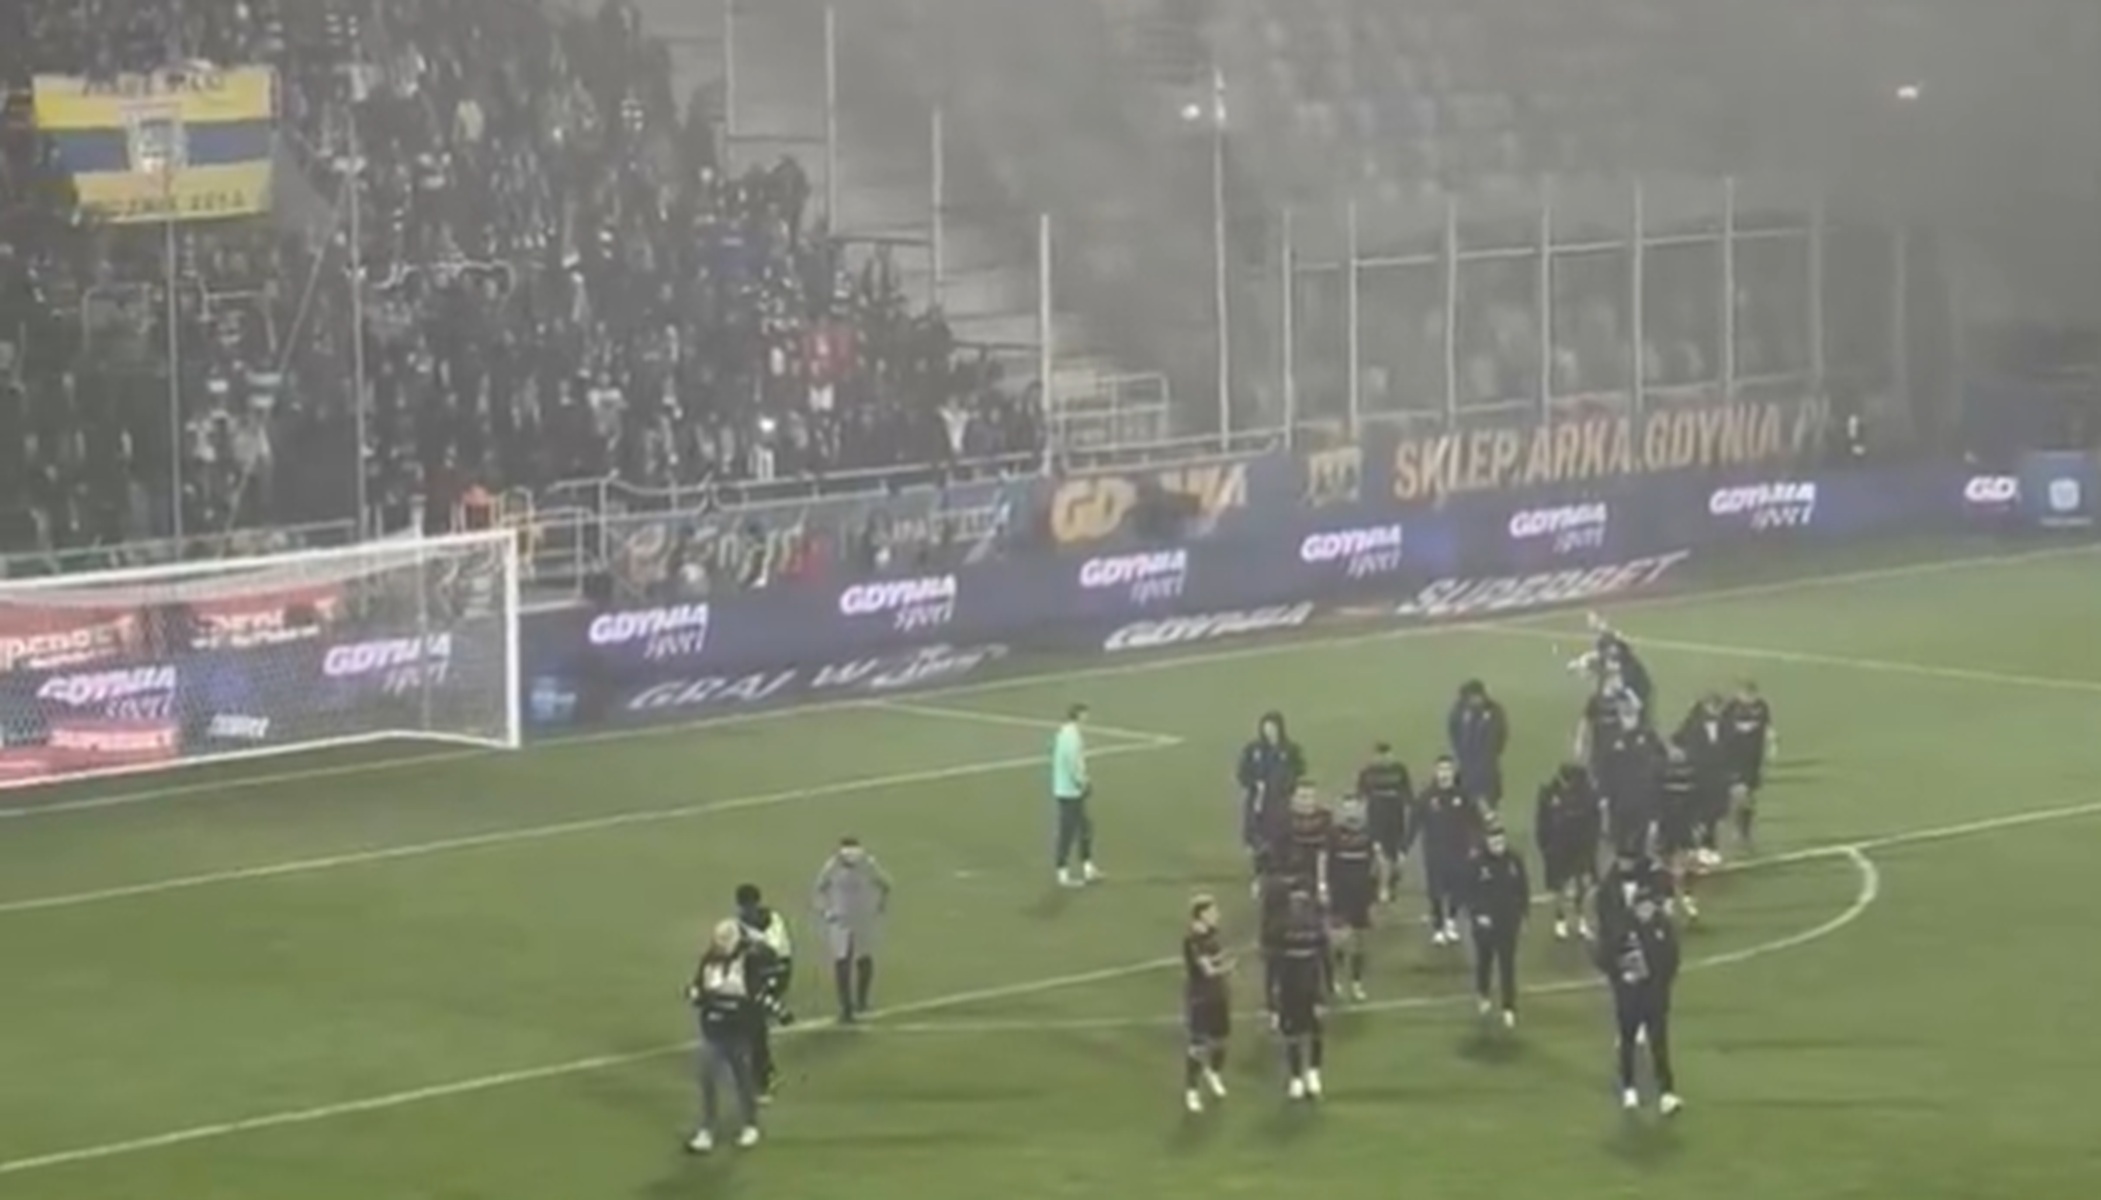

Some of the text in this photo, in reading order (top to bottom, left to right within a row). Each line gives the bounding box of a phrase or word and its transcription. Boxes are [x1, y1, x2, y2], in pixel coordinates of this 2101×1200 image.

[1710, 482, 1816, 516] GDYNIA
[1510, 502, 1606, 538] GDYNIA
[1301, 525, 1403, 561] GDYNIA
[1080, 549, 1187, 587] GDYNIA
[840, 574, 957, 616] GDYNIA
[589, 603, 709, 645] GDYNIA
